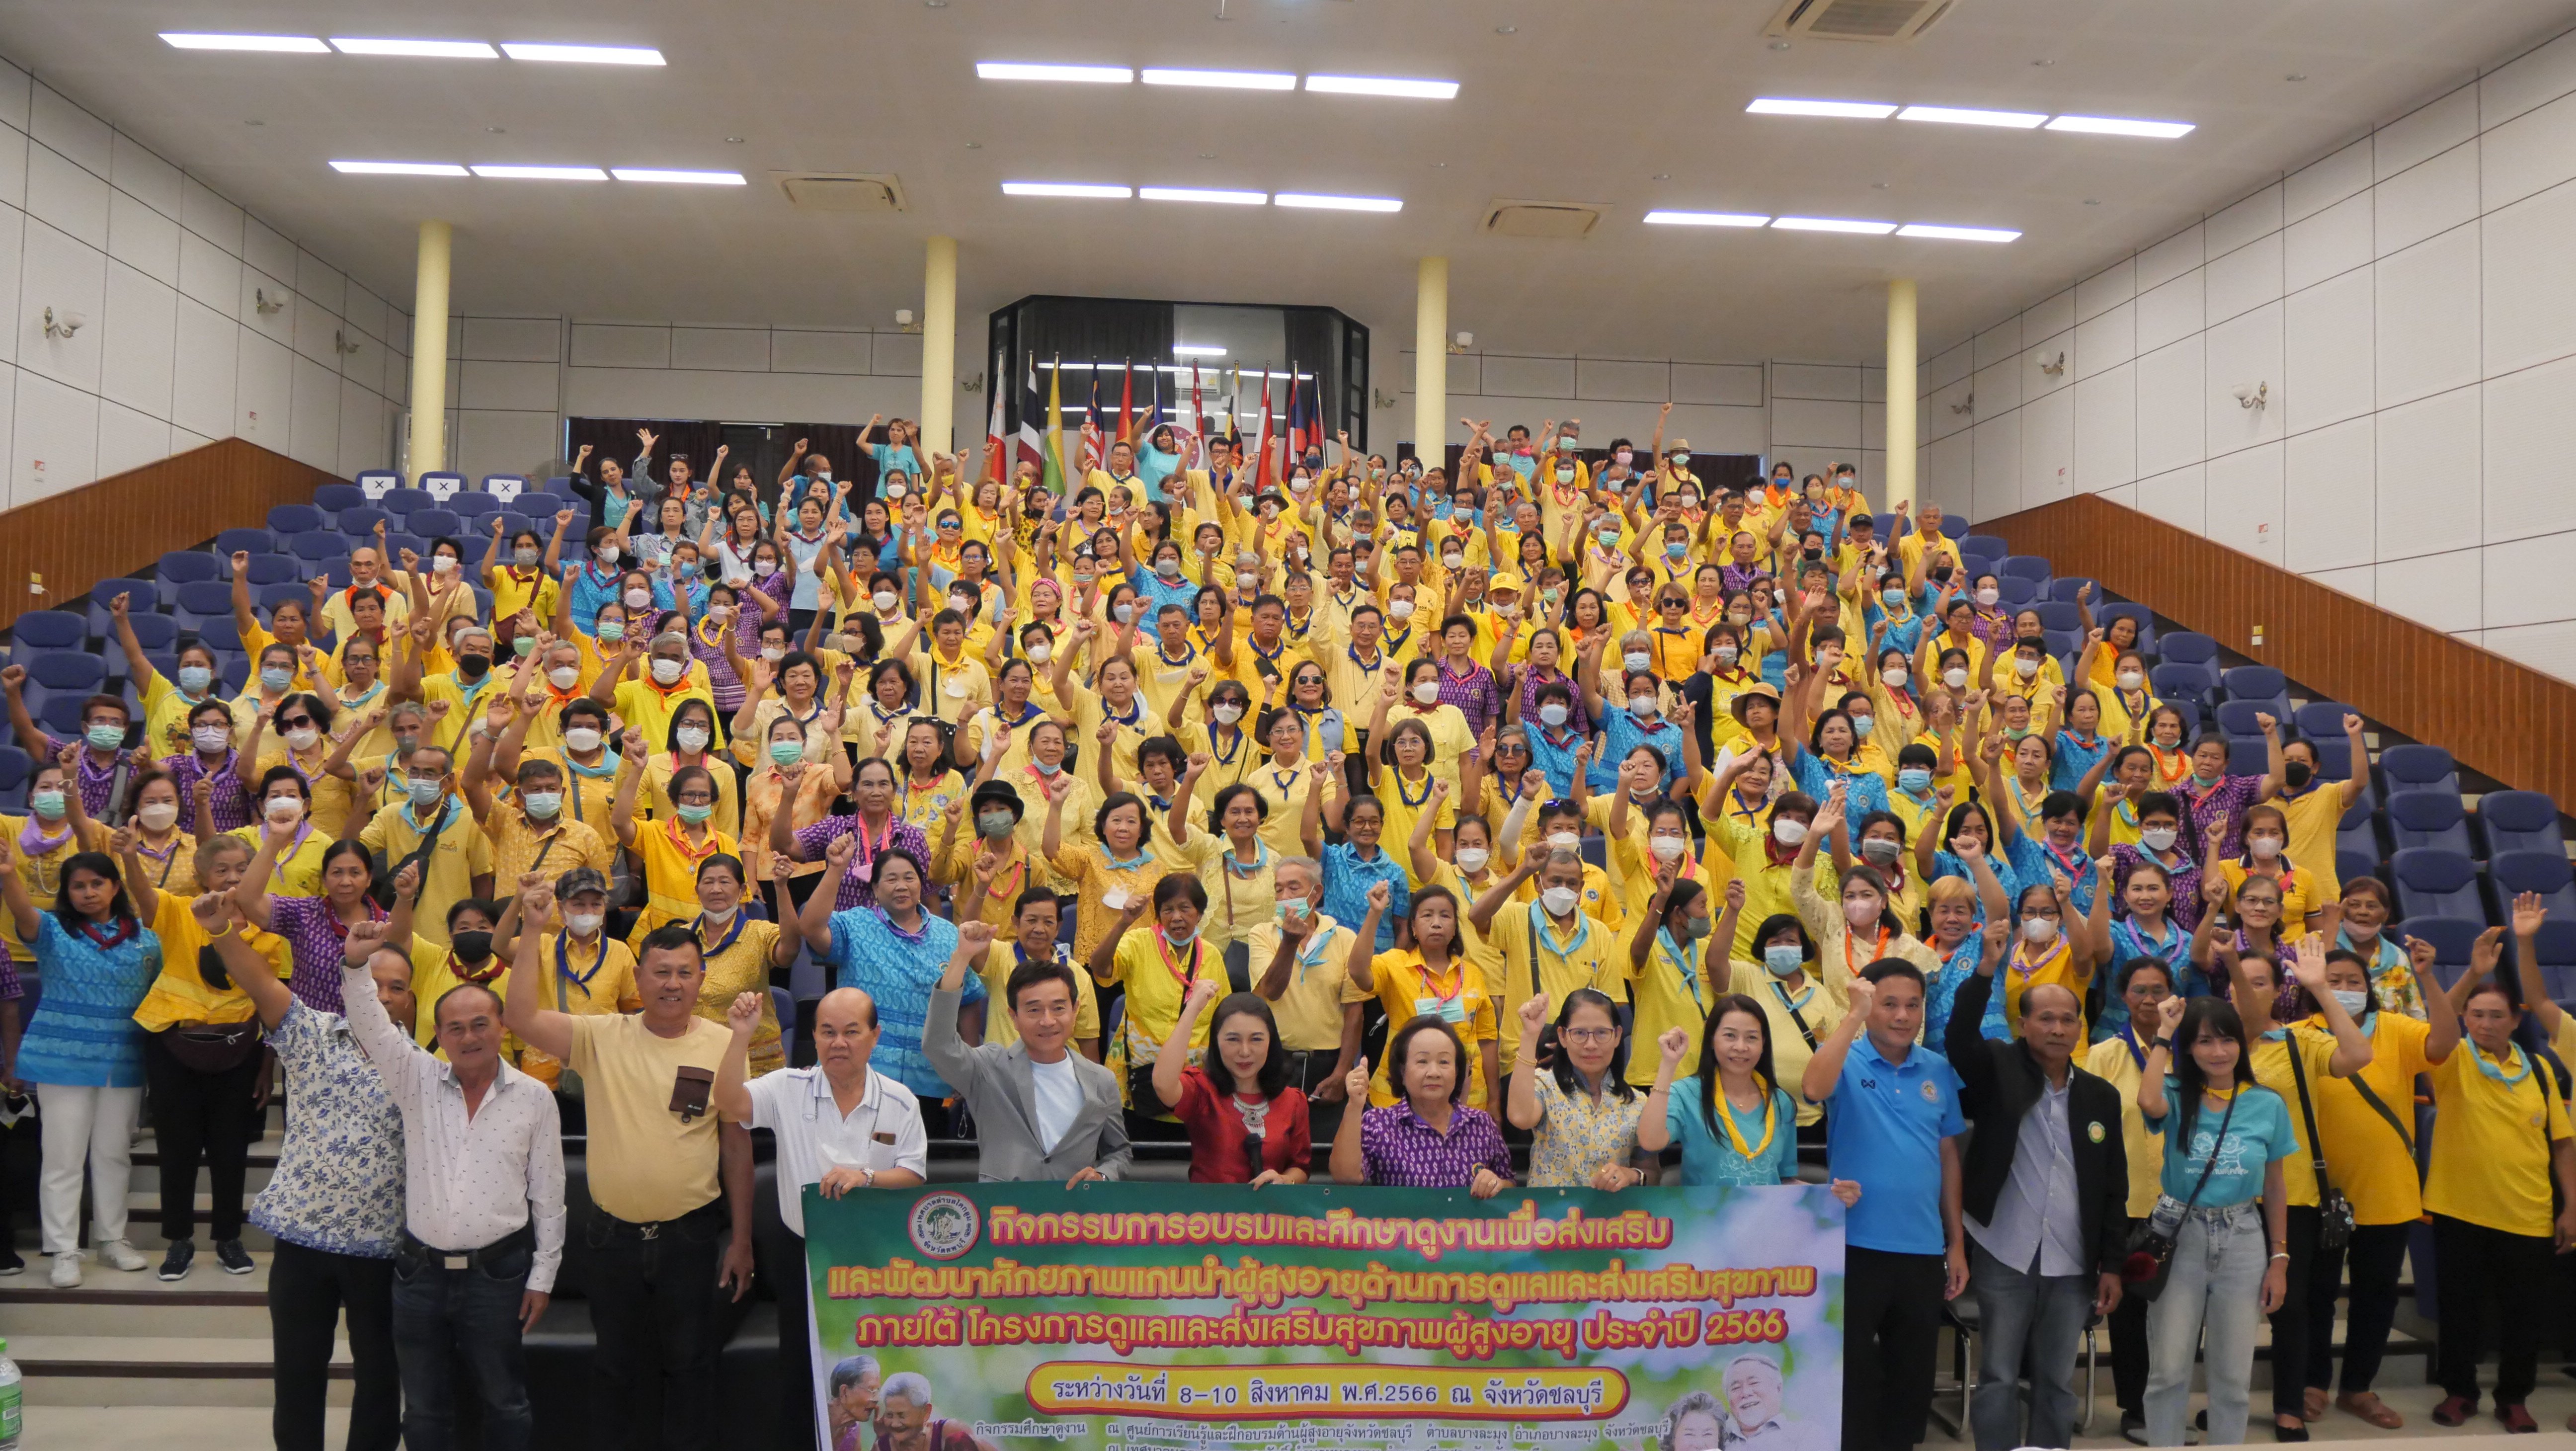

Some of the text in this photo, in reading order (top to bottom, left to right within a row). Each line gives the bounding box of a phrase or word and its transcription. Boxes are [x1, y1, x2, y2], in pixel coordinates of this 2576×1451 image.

[990, 1204, 1669, 1258] กิจกรรมการอบรมและศึกษาดูงานเพื่อส่งเสริม
[829, 1258, 1815, 1311] และพัฒนาศักยภาพแกนนำผู้สูงอายุด้านการดูแลและส่งเสริมสุขภาพ
[858, 1304, 1784, 1358] ภายใต้ โครงการดูแลและส่งเสริมสุขภาพผู้สูงอายุ ประจำปี 2566
[1053, 1373, 1166, 1402] ระหว่างวันที่
[1250, 1380, 1329, 1403] สิงหาคม
[1343, 1384, 1437, 1402] พ.ศ.2566
[1452, 1387, 1471, 1403] ณ
[1485, 1380, 1602, 1412] จังหวัดชลบุรี
[976, 1419, 1670, 1445] กิจกรรมศึกษาดูงาน ณ ศูนย์การเรียนรู้และฝึกอบรมด้านผู้สูงอายุจังหวัดชลบุรี ตำบลบางละมุง อำเภอบางละมุง จังหวัดชลบุรี
